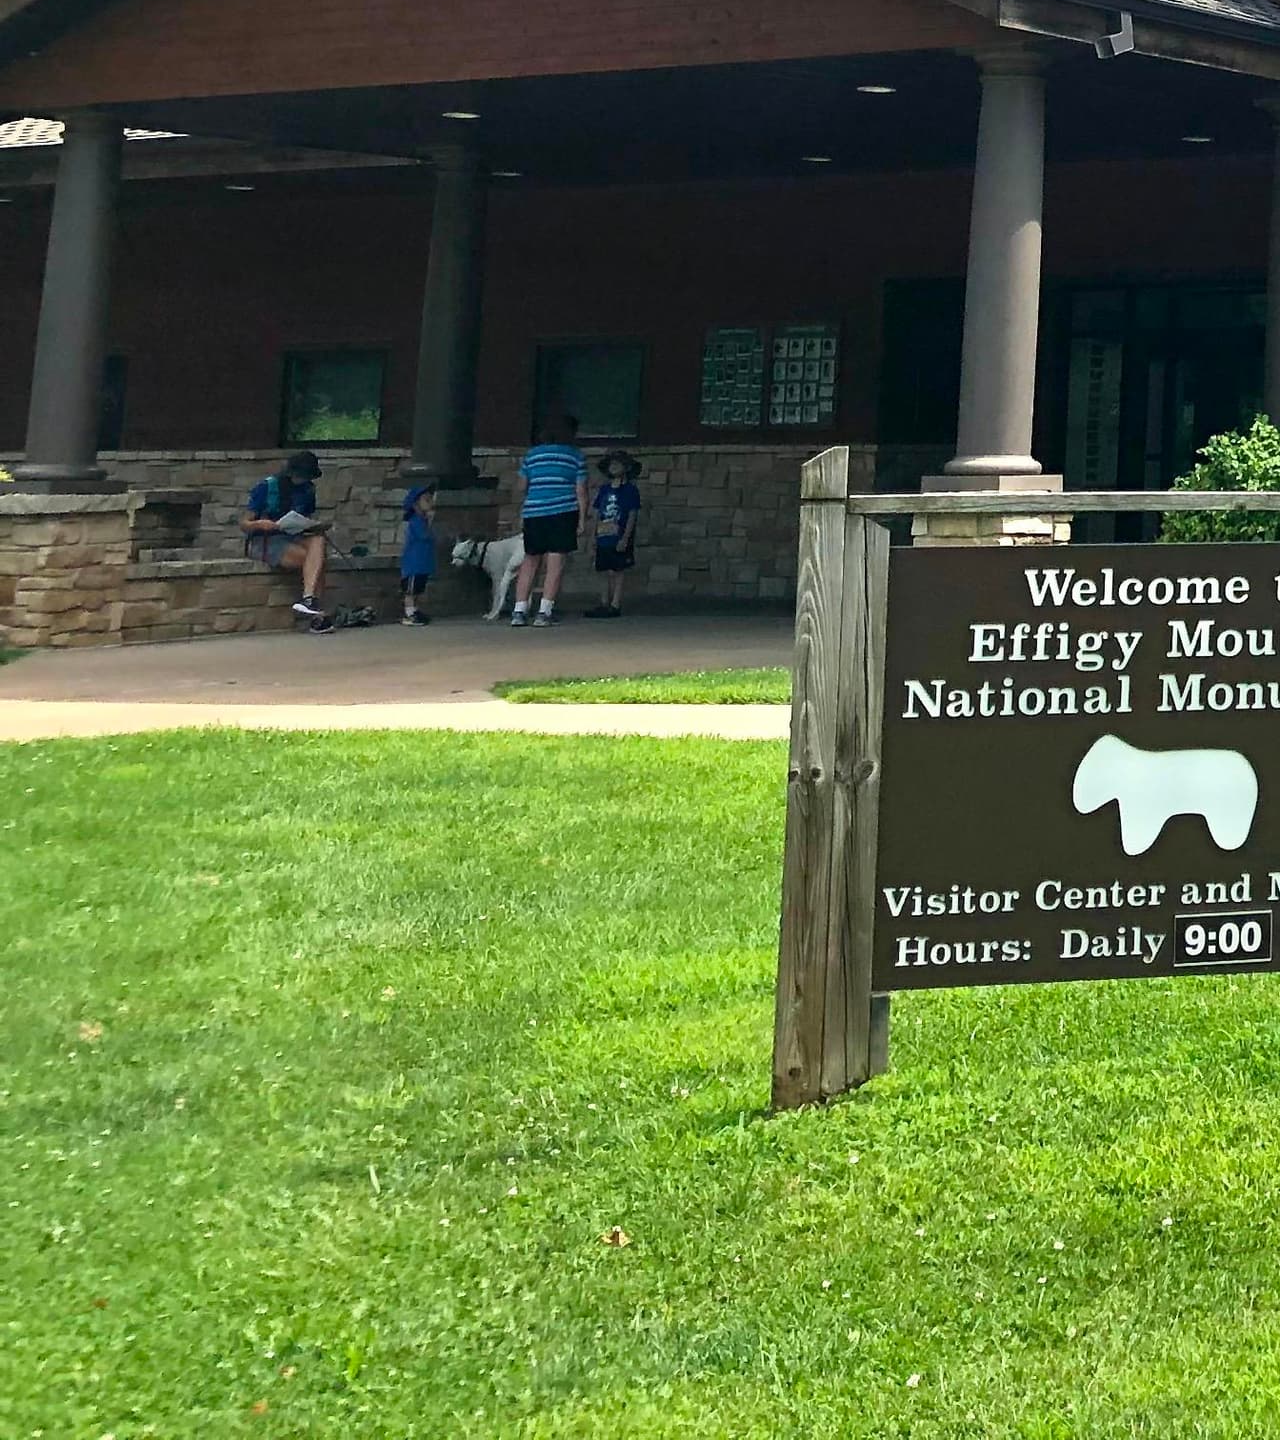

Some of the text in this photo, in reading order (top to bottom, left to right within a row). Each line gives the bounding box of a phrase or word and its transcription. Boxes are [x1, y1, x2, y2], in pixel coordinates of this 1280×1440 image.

[1024, 568, 1250, 607] Welcome
[967, 622, 1143, 672] Effigy
[902, 675, 1133, 718] National
[882, 884, 1020, 917] Visitor
[1035, 880, 1166, 911] Center
[1180, 873, 1252, 905] and
[894, 936, 1032, 967] Hours:
[1059, 926, 1166, 964] Daily
[1184, 921, 1262, 956] 9:00
